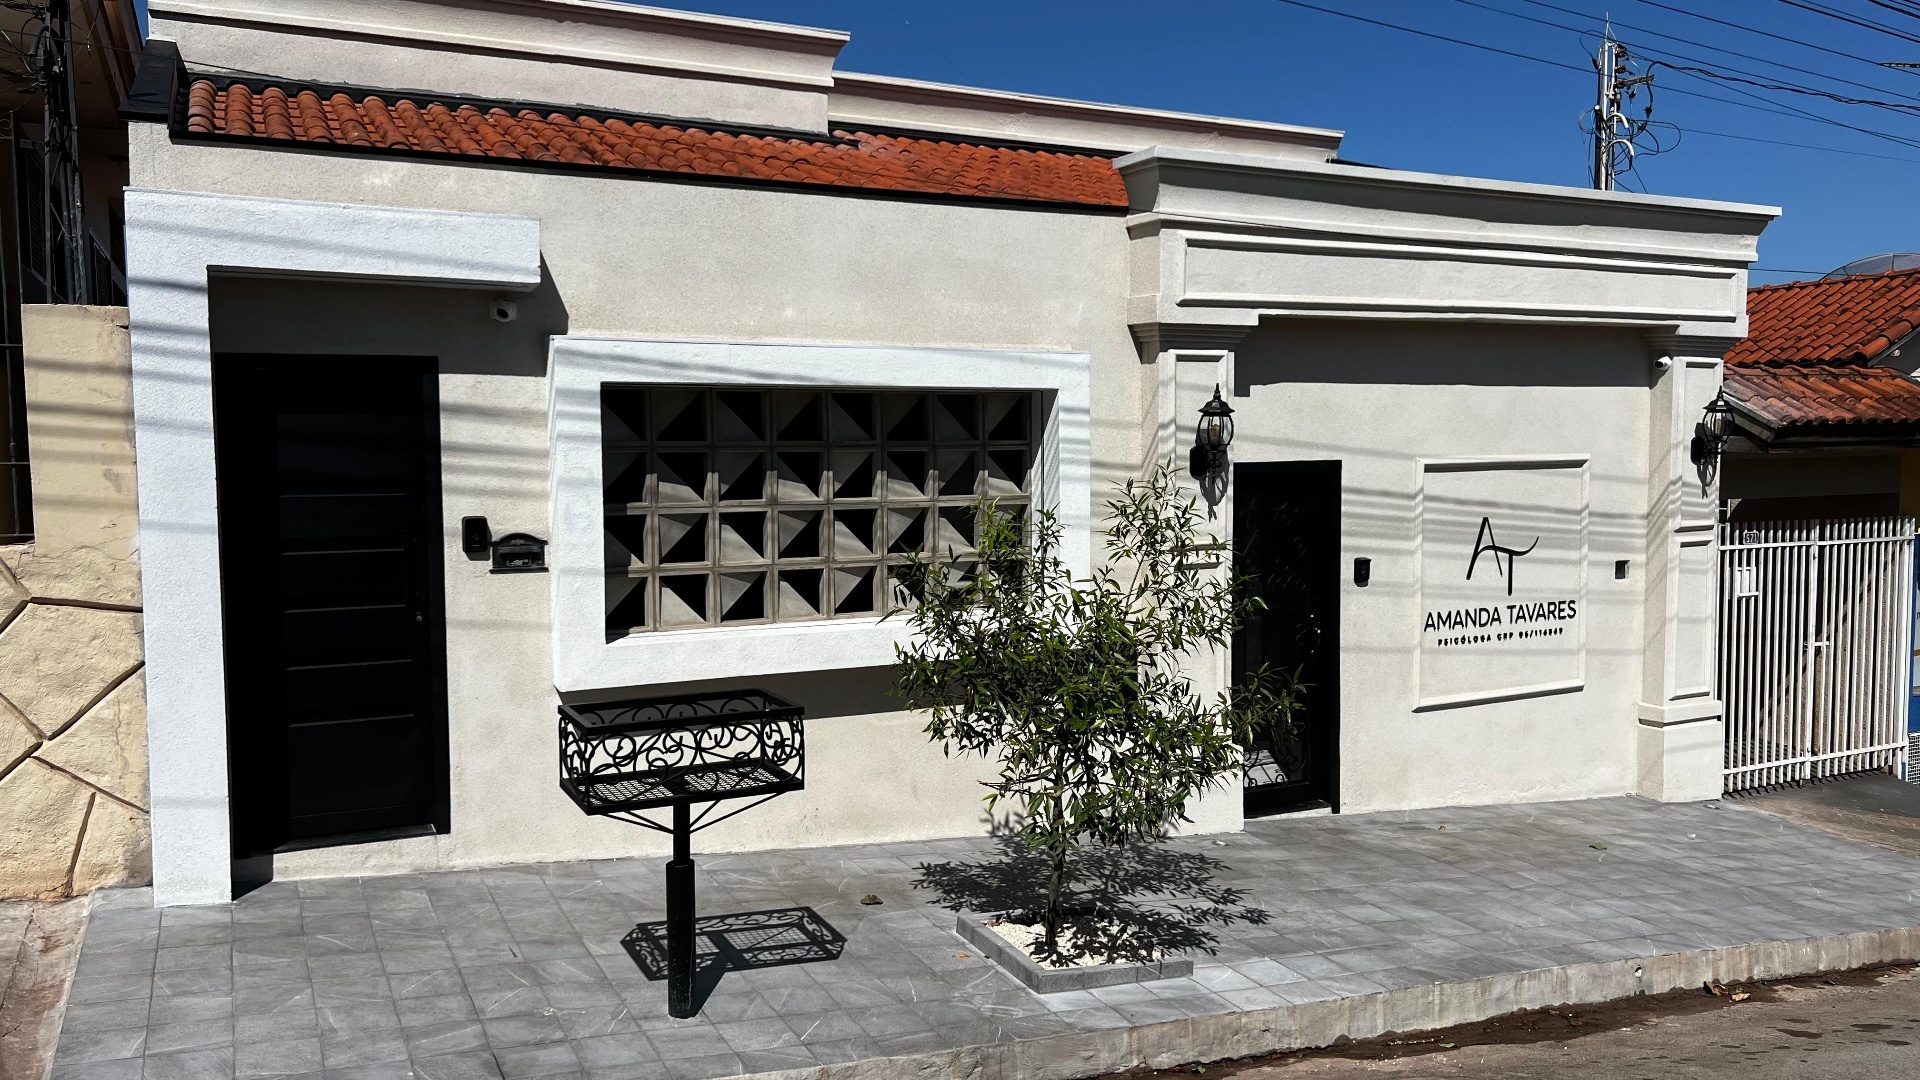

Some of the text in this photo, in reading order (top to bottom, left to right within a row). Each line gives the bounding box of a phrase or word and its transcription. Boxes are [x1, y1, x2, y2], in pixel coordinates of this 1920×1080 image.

[1424, 599, 1577, 633] AMANDA TAVARES
[1437, 634, 1492, 647] PSICÓLOGA
[1497, 632, 1514, 642] CRP
